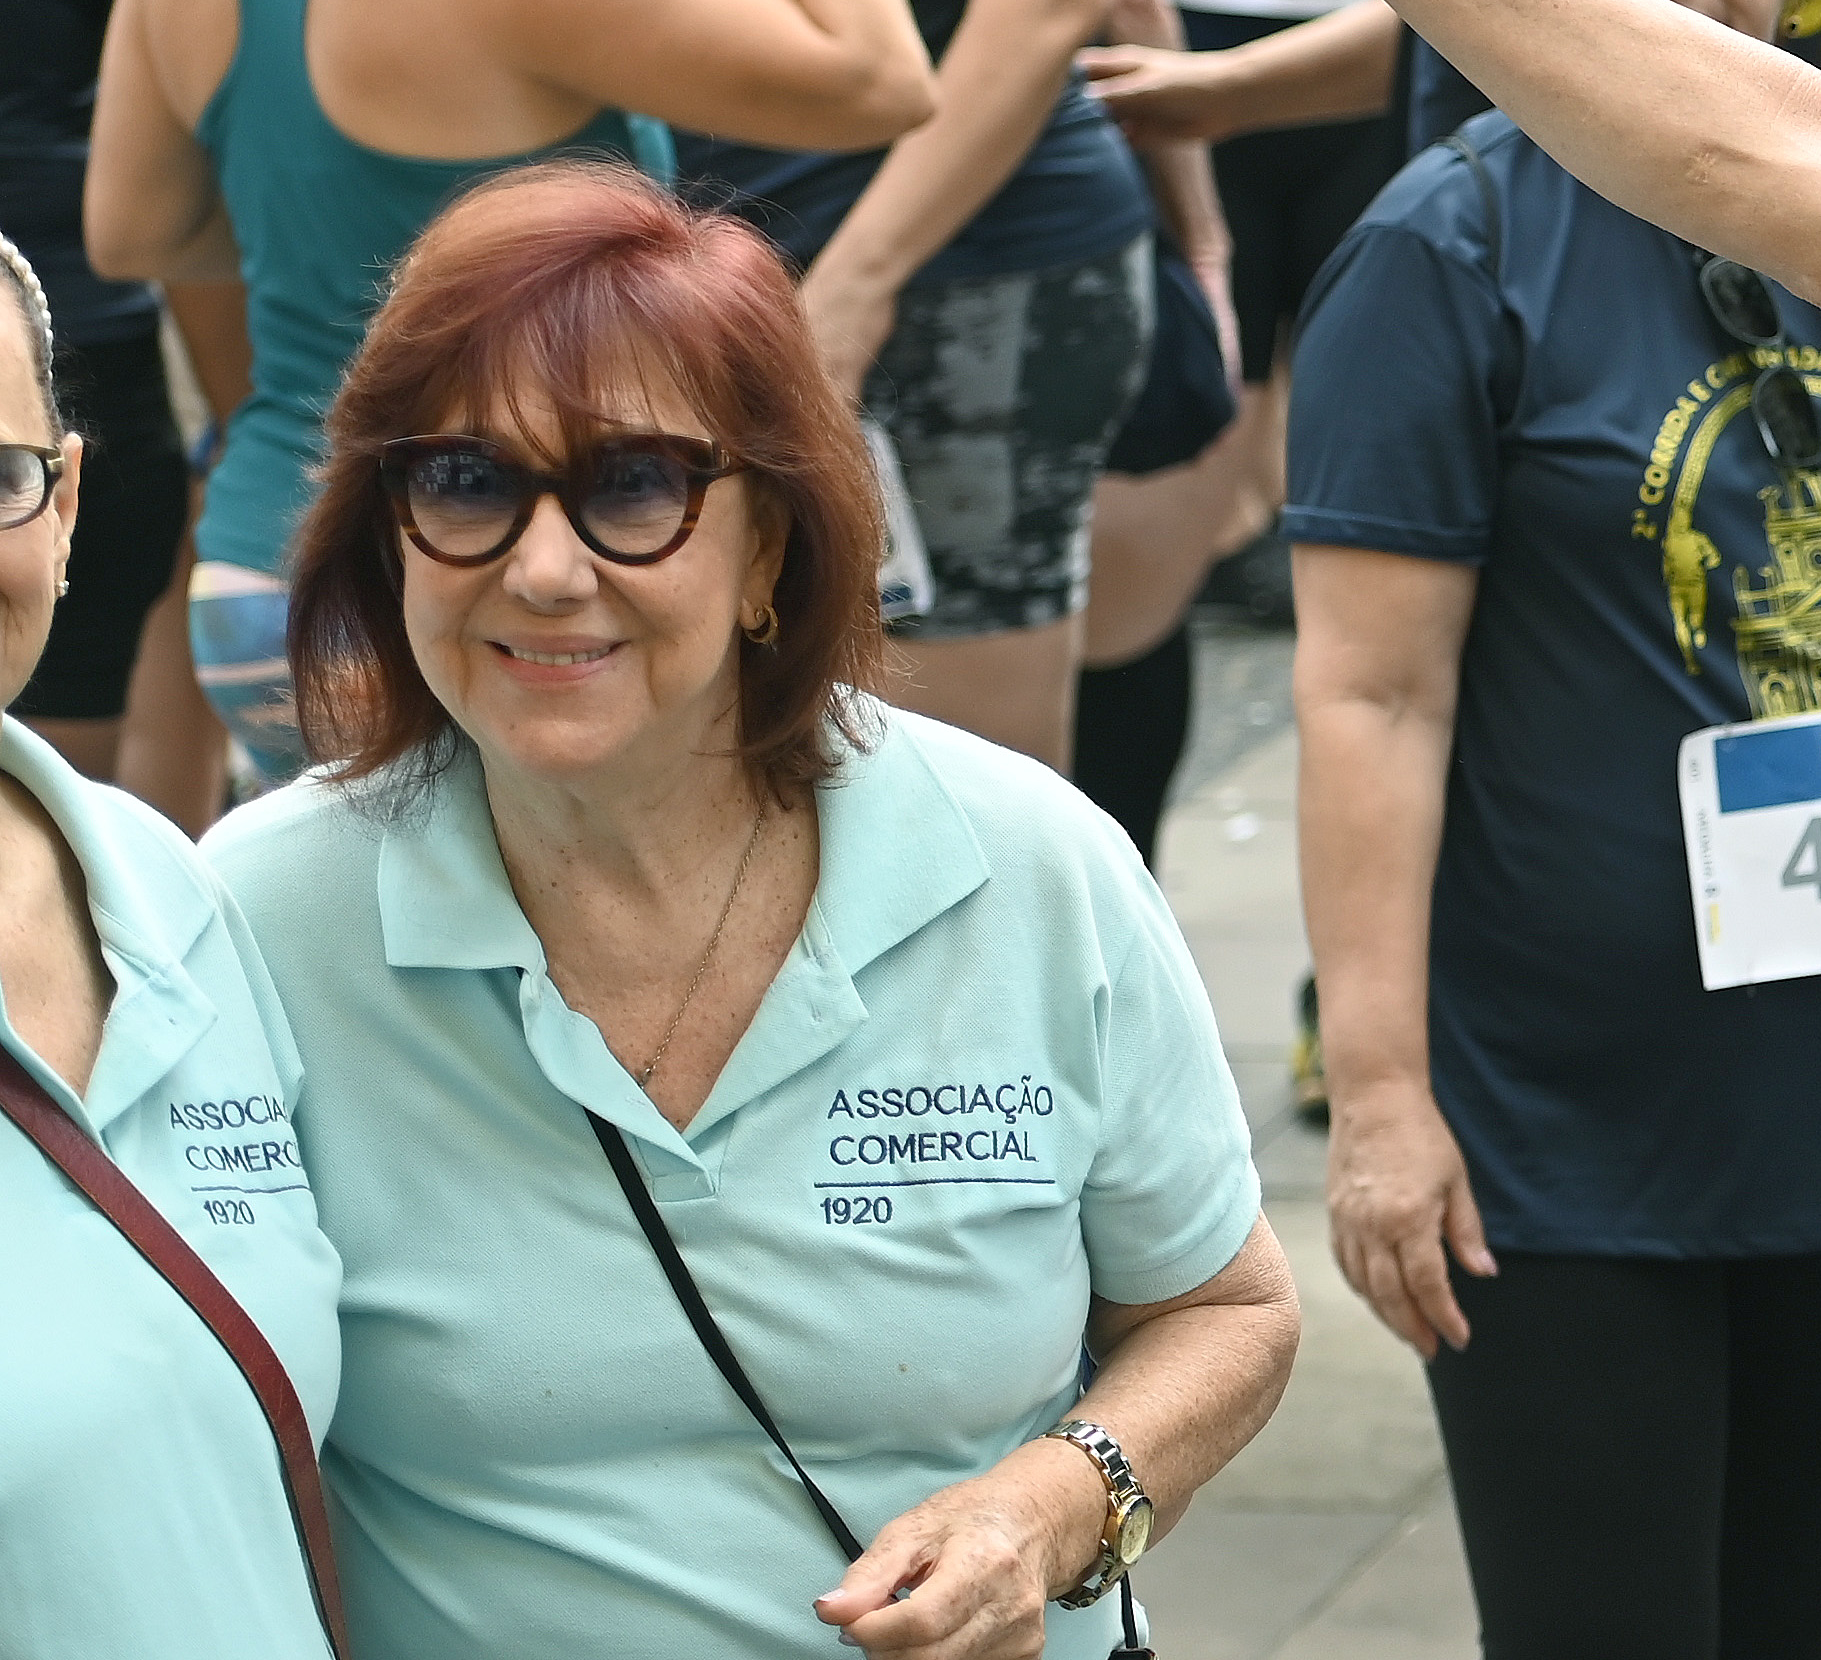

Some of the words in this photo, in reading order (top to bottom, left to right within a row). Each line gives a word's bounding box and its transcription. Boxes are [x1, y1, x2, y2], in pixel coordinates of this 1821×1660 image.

[169, 1094, 288, 1131] ASSOCIA
[827, 1074, 1054, 1125] ASSOCIAÇÃO
[829, 1130, 1040, 1166] COMERCIAL
[203, 1199, 256, 1226] 1920
[819, 1196, 893, 1225] 1920
